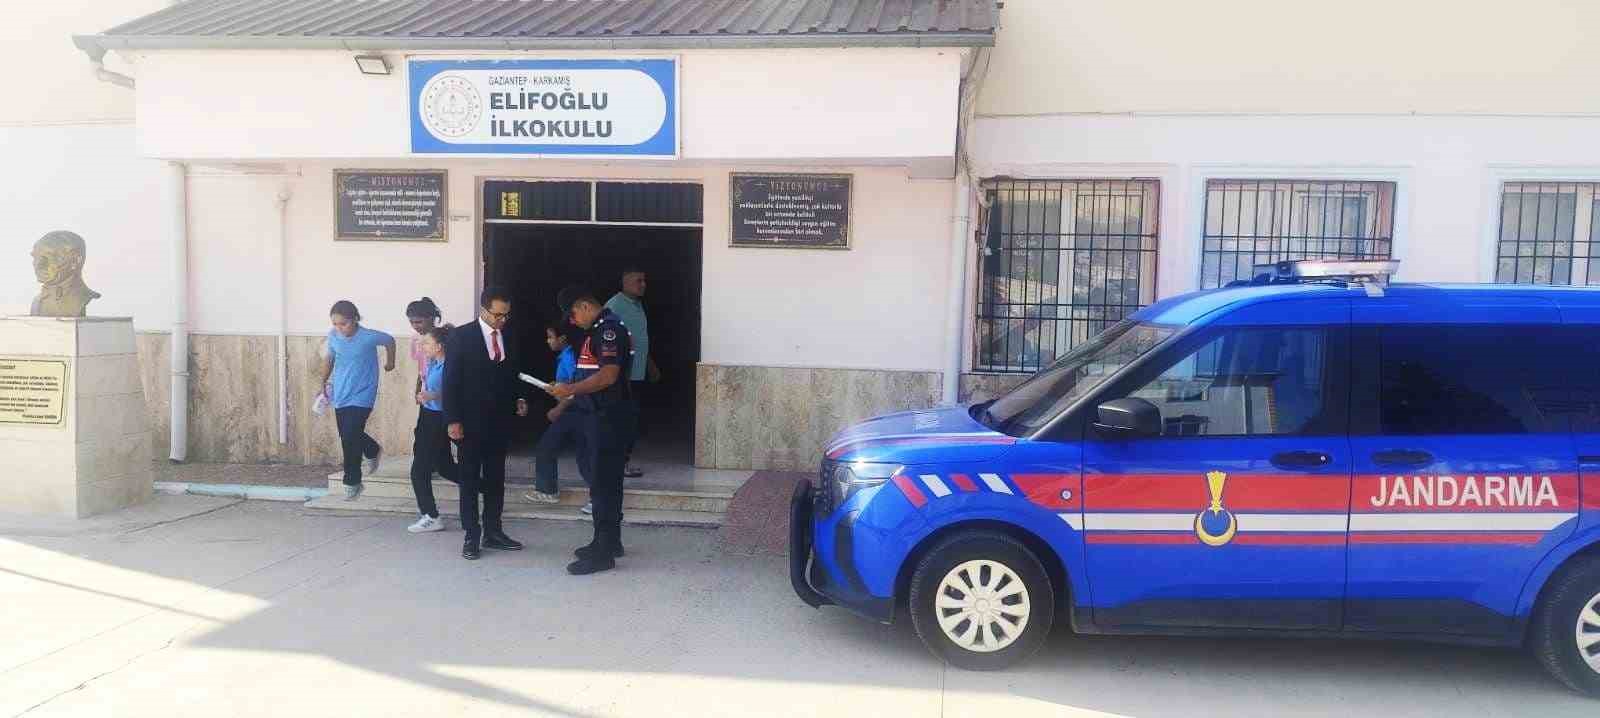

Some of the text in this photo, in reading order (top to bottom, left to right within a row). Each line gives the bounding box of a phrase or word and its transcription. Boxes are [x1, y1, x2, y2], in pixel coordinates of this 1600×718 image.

[490, 87, 608, 110] ELİFOĞLU
[490, 114, 612, 138] İLKOKULU
[1371, 476, 1559, 507] JANDARMA
